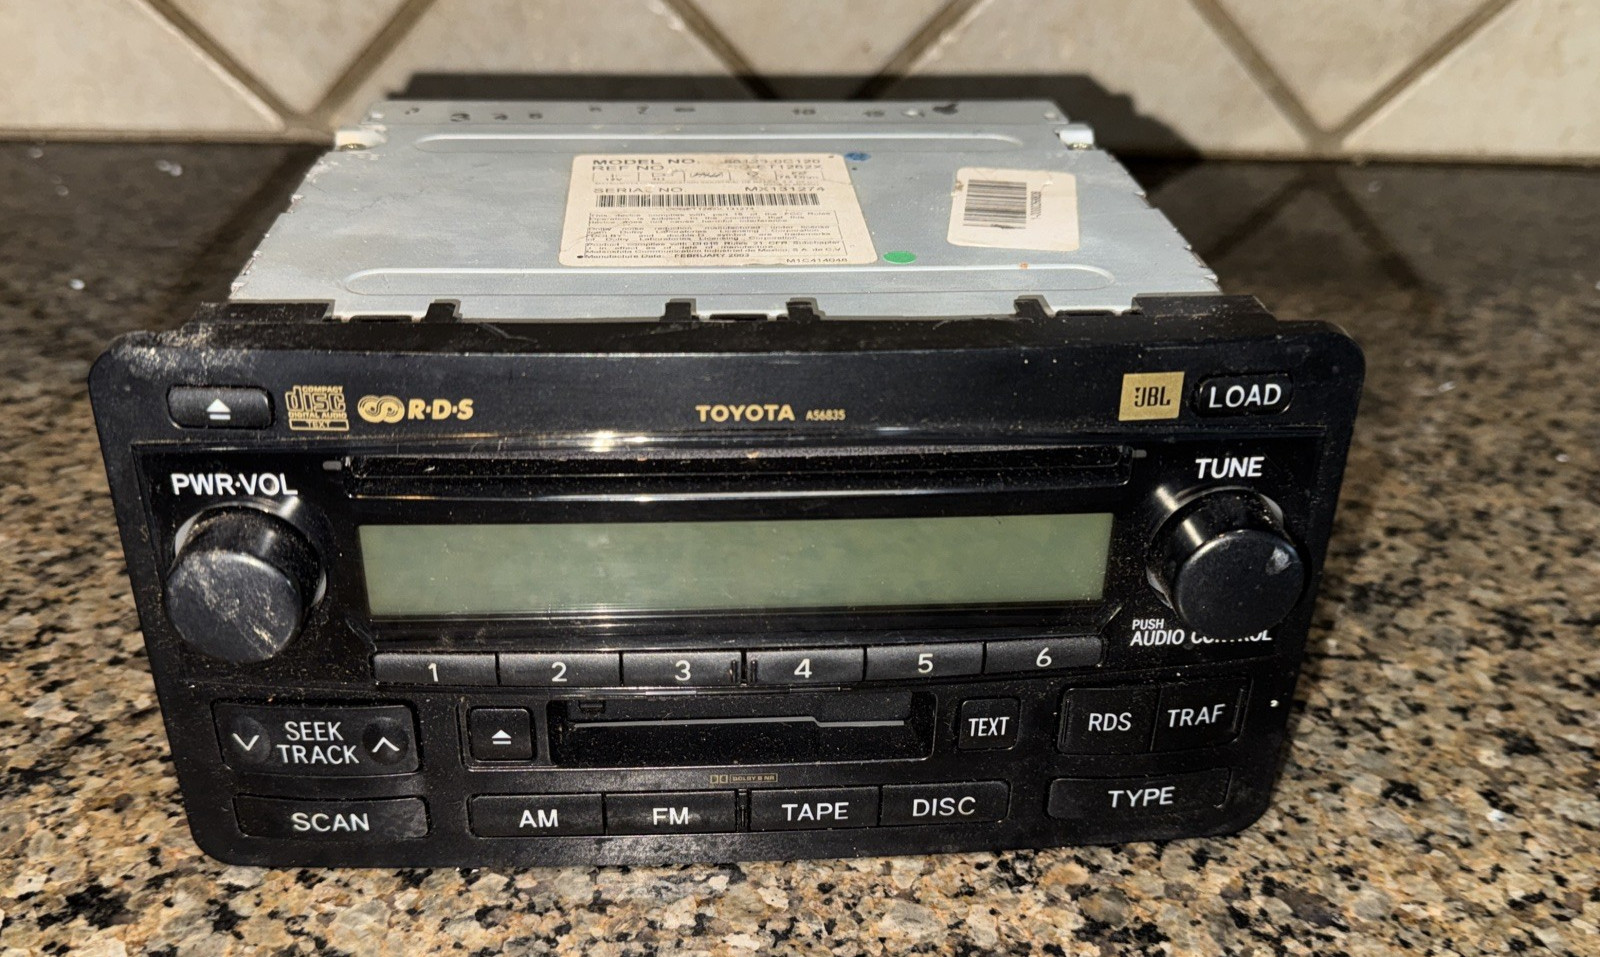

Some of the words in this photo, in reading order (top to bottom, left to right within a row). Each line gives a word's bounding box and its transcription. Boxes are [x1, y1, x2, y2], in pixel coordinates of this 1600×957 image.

[302, 385, 343, 393] COMPACT
[1134, 386, 1171, 408] JBL
[1208, 383, 1282, 408] LOAD
[695, 404, 796, 422] TOYOTA
[1195, 456, 1265, 479] TUNE
[1131, 618, 1165, 630] PUSH
[1130, 629, 1185, 647] AUDIO
[794, 657, 812, 679] 4
[917, 653, 934, 674] 5
[1036, 647, 1052, 668] 6
[427, 662, 439, 682] 1
[551, 661, 568, 682] 2
[674, 659, 692, 682] 3
[1088, 712, 1132, 732] RDS
[1167, 703, 1226, 728] TRAF
[284, 721, 342, 742] SEEK
[968, 716, 1010, 737] TEXT
[276, 744, 360, 765] TRACK
[912, 796, 976, 817] DISC
[1108, 786, 1176, 808] TYPE
[519, 808, 559, 828] AM
[652, 806, 690, 826] FM
[781, 801, 850, 821] TAPE
[290, 812, 370, 832] SCAN
